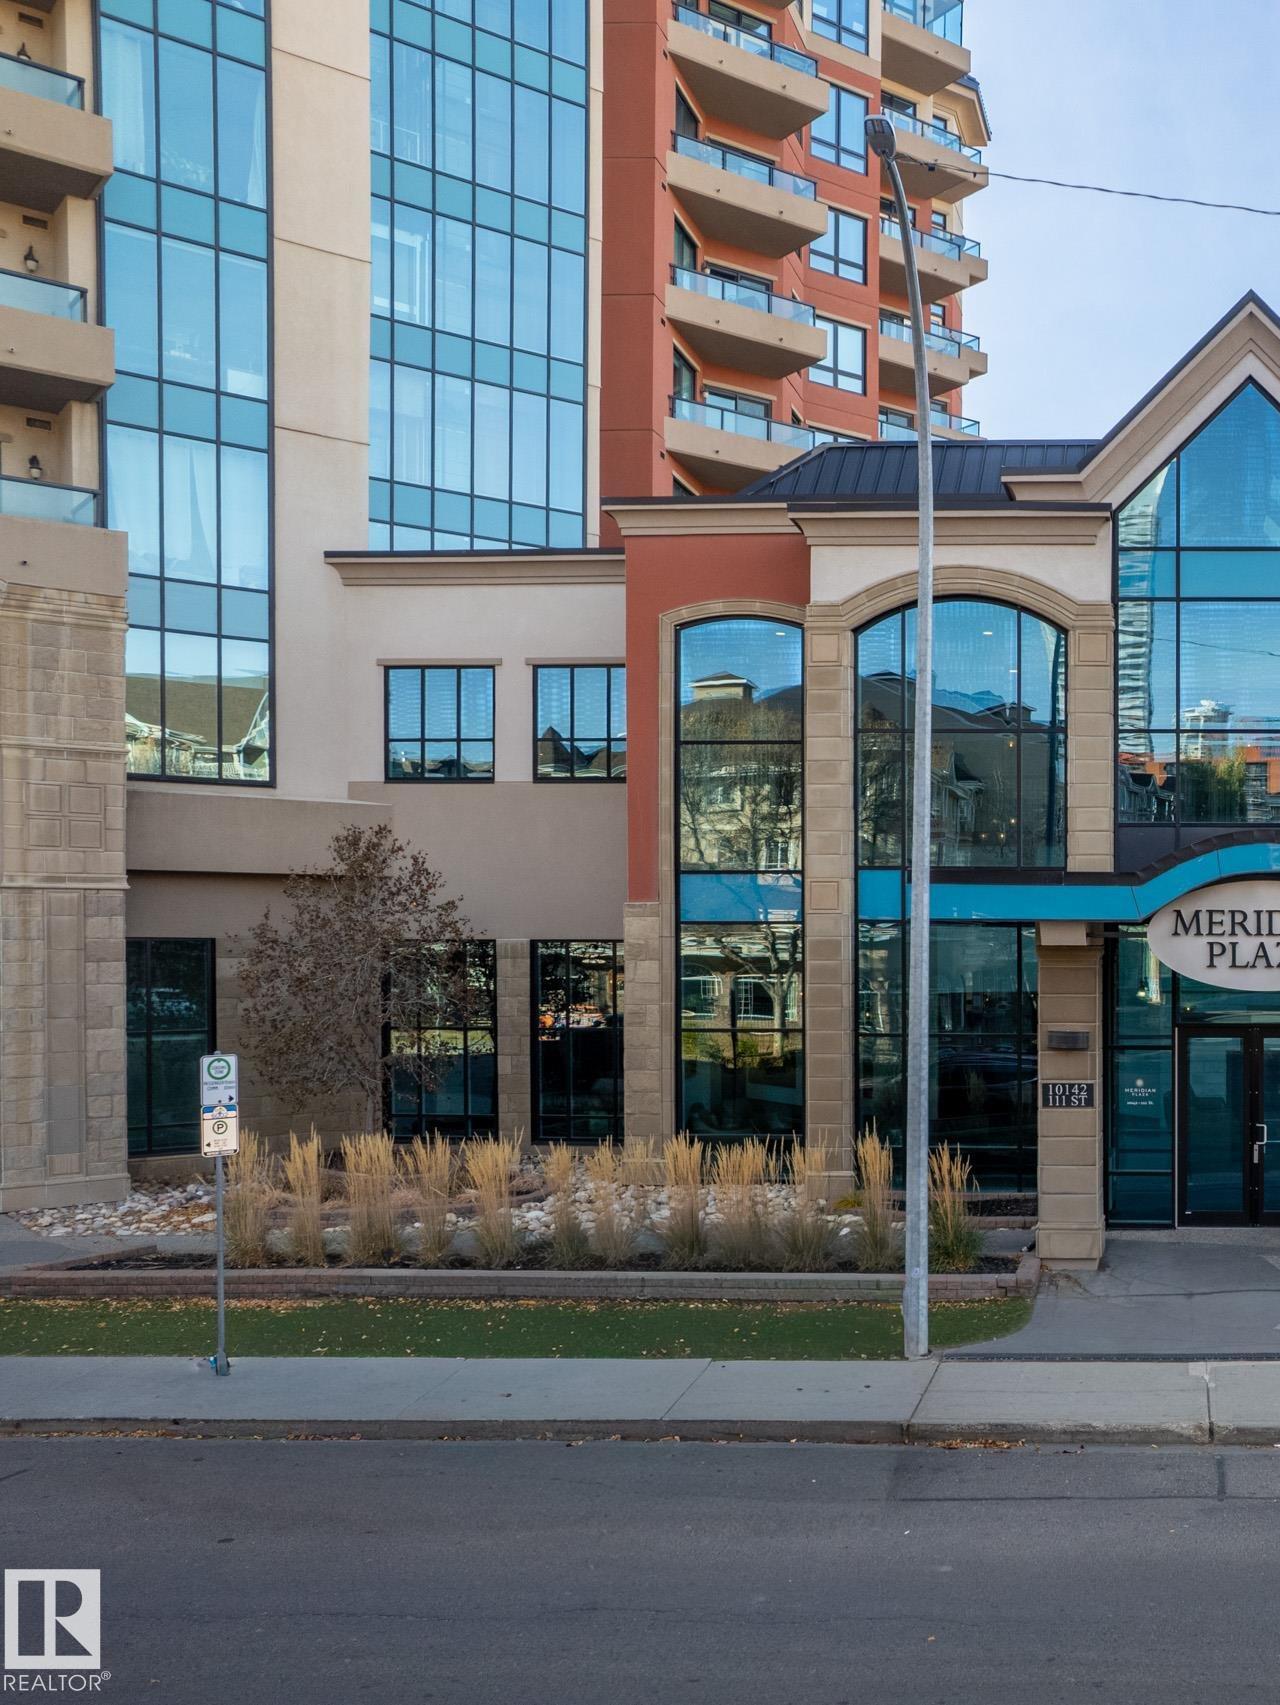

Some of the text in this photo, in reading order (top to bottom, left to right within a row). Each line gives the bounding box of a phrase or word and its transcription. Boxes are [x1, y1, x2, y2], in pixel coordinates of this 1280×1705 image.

[1048, 1084, 1088, 1095] 10142
[1048, 1095, 1088, 1106] 111 ST
